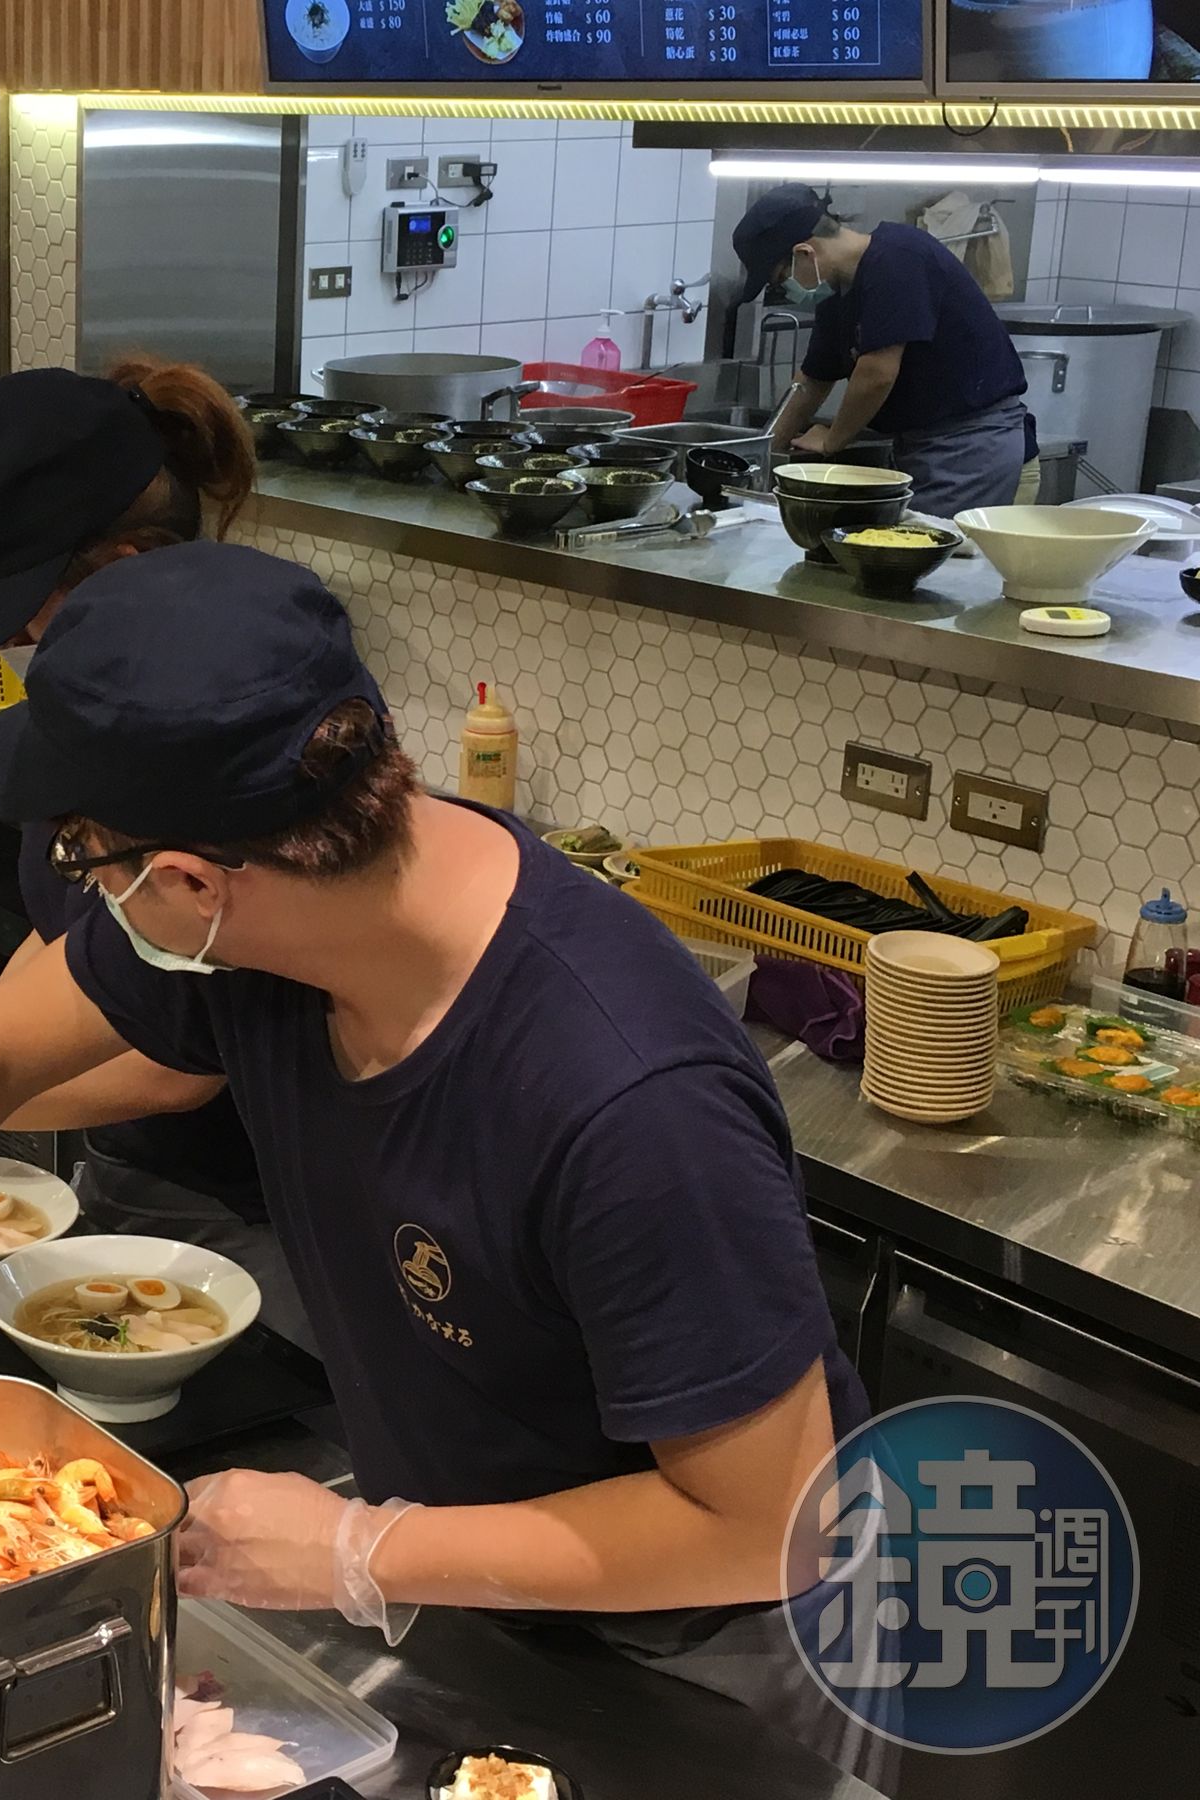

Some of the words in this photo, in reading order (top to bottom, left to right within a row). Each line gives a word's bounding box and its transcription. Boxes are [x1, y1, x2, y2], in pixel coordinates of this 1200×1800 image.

[389, 0, 405, 10] 150
[595, 9, 611, 24] 60
[719, 5, 736, 20] 30
[843, 7, 860, 21] 60
[389, 16, 401, 29] 80
[596, 29, 611, 44] 90
[720, 26, 736, 41] 30
[844, 26, 860, 40] 60
[720, 47, 737, 62] 30
[844, 46, 860, 60] 30
